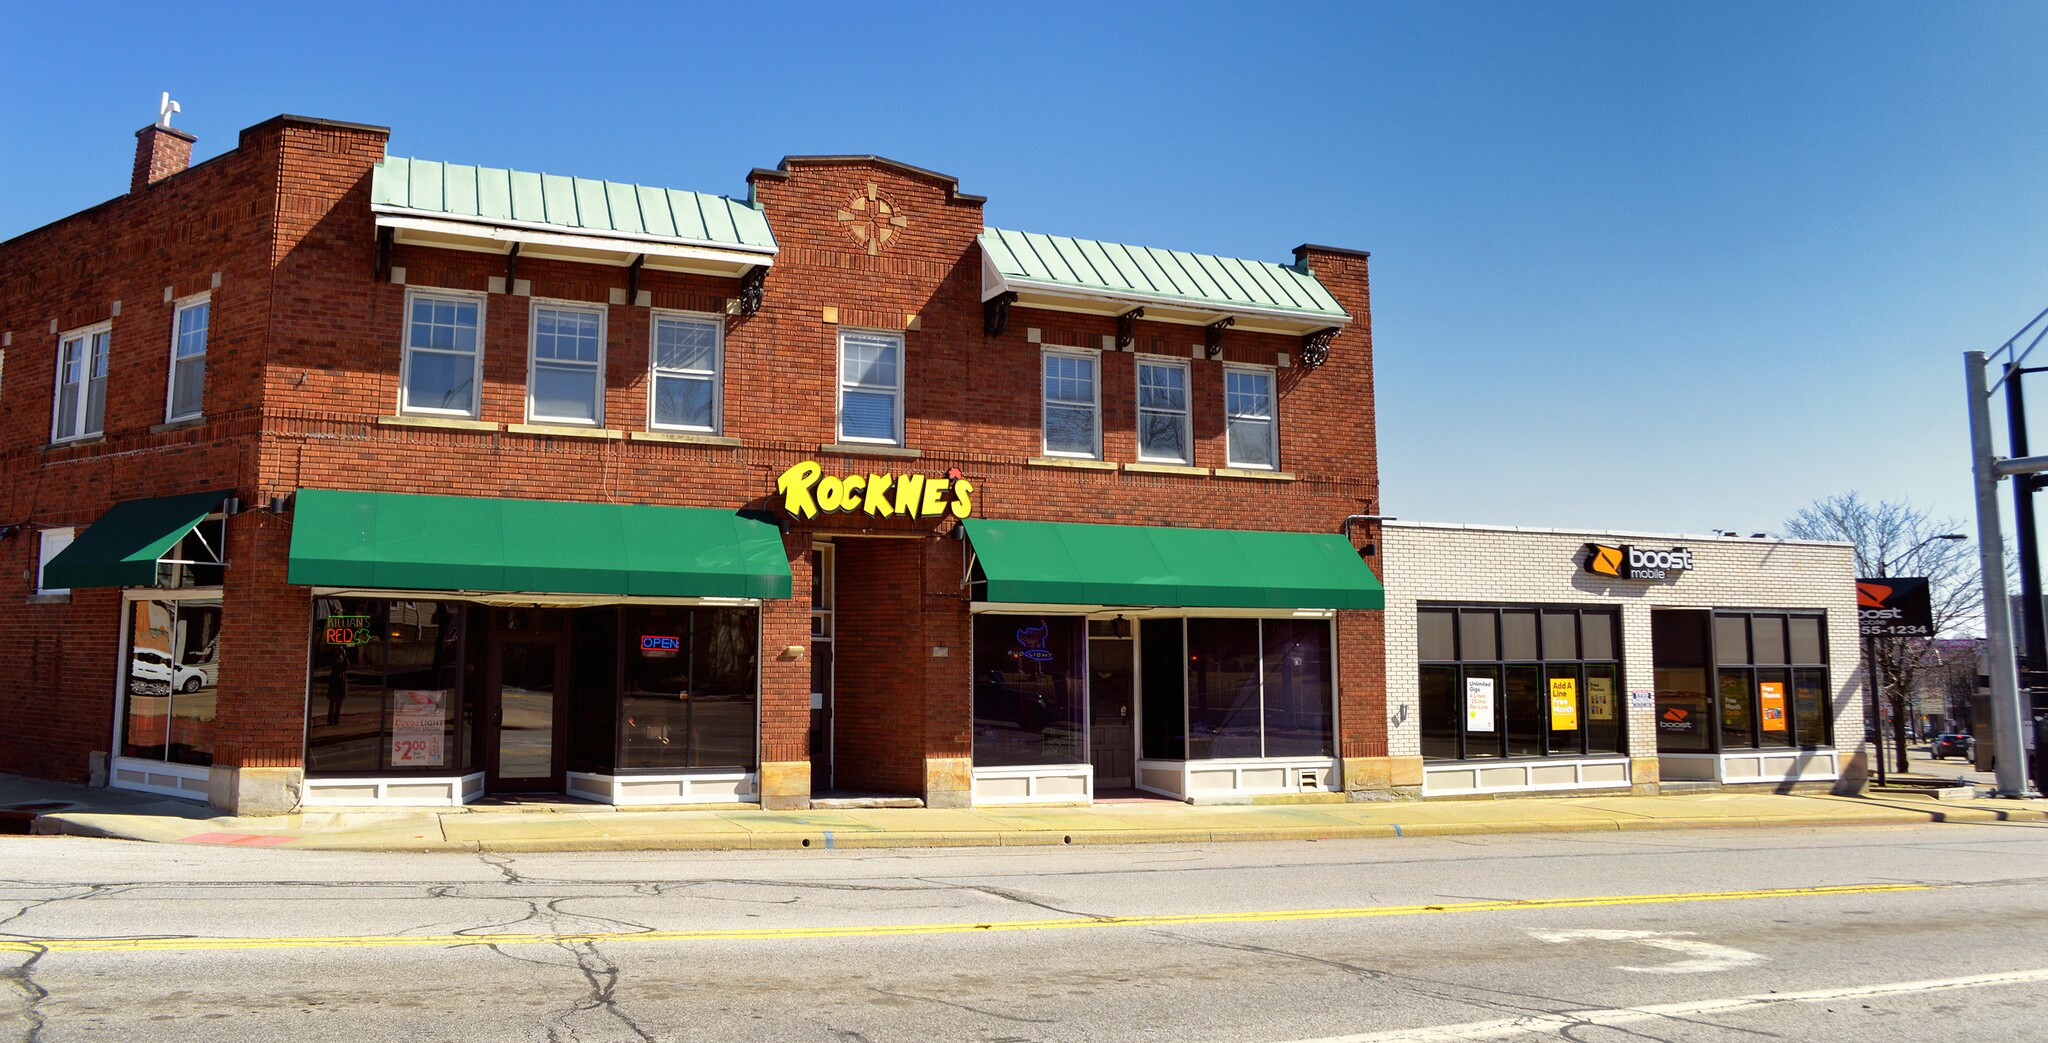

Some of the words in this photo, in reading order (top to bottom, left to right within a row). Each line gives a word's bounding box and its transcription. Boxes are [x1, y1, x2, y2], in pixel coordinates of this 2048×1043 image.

[777, 460, 974, 521] ROCKNE'S
[1628, 546, 1693, 569] boost
[1630, 568, 1666, 579] mobile
[1858, 607, 1902, 619] oost
[326, 628, 353, 643] RED
[1861, 625, 1928, 635] 55-1234
[643, 637, 679, 649] OPEN
[1554, 705, 1574, 713] Month
[420, 719, 443, 727] LIGHT
